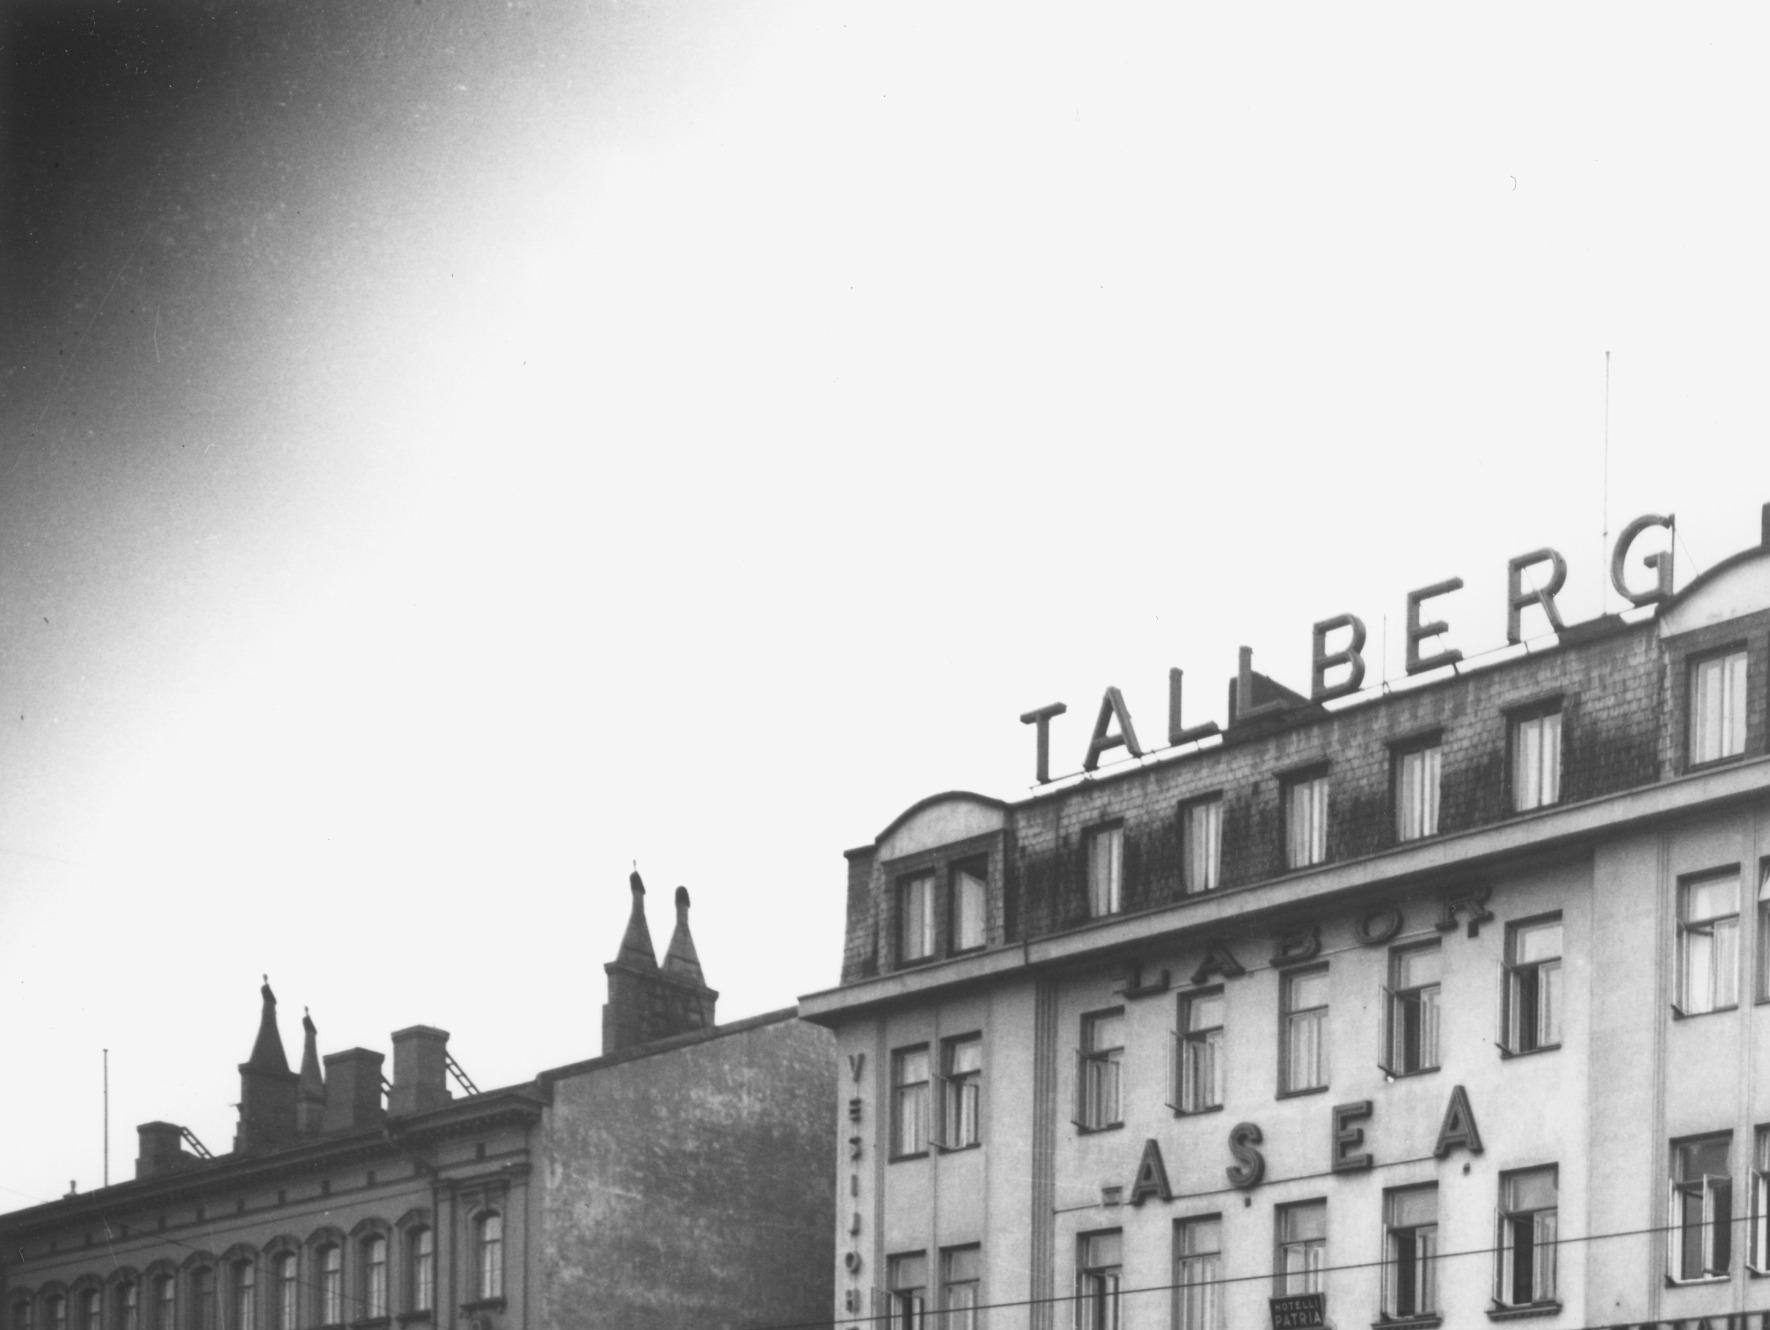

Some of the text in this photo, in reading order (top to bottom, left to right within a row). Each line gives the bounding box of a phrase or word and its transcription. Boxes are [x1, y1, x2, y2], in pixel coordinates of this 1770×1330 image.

[1020, 513, 1676, 783] TALLBERG
[1120, 884, 1494, 1001] LABOR
[1131, 1084, 1484, 1207] ASEA
[1275, 1299, 1318, 1312] HOTELLI
[1275, 1311, 1321, 1327] PATRIA
